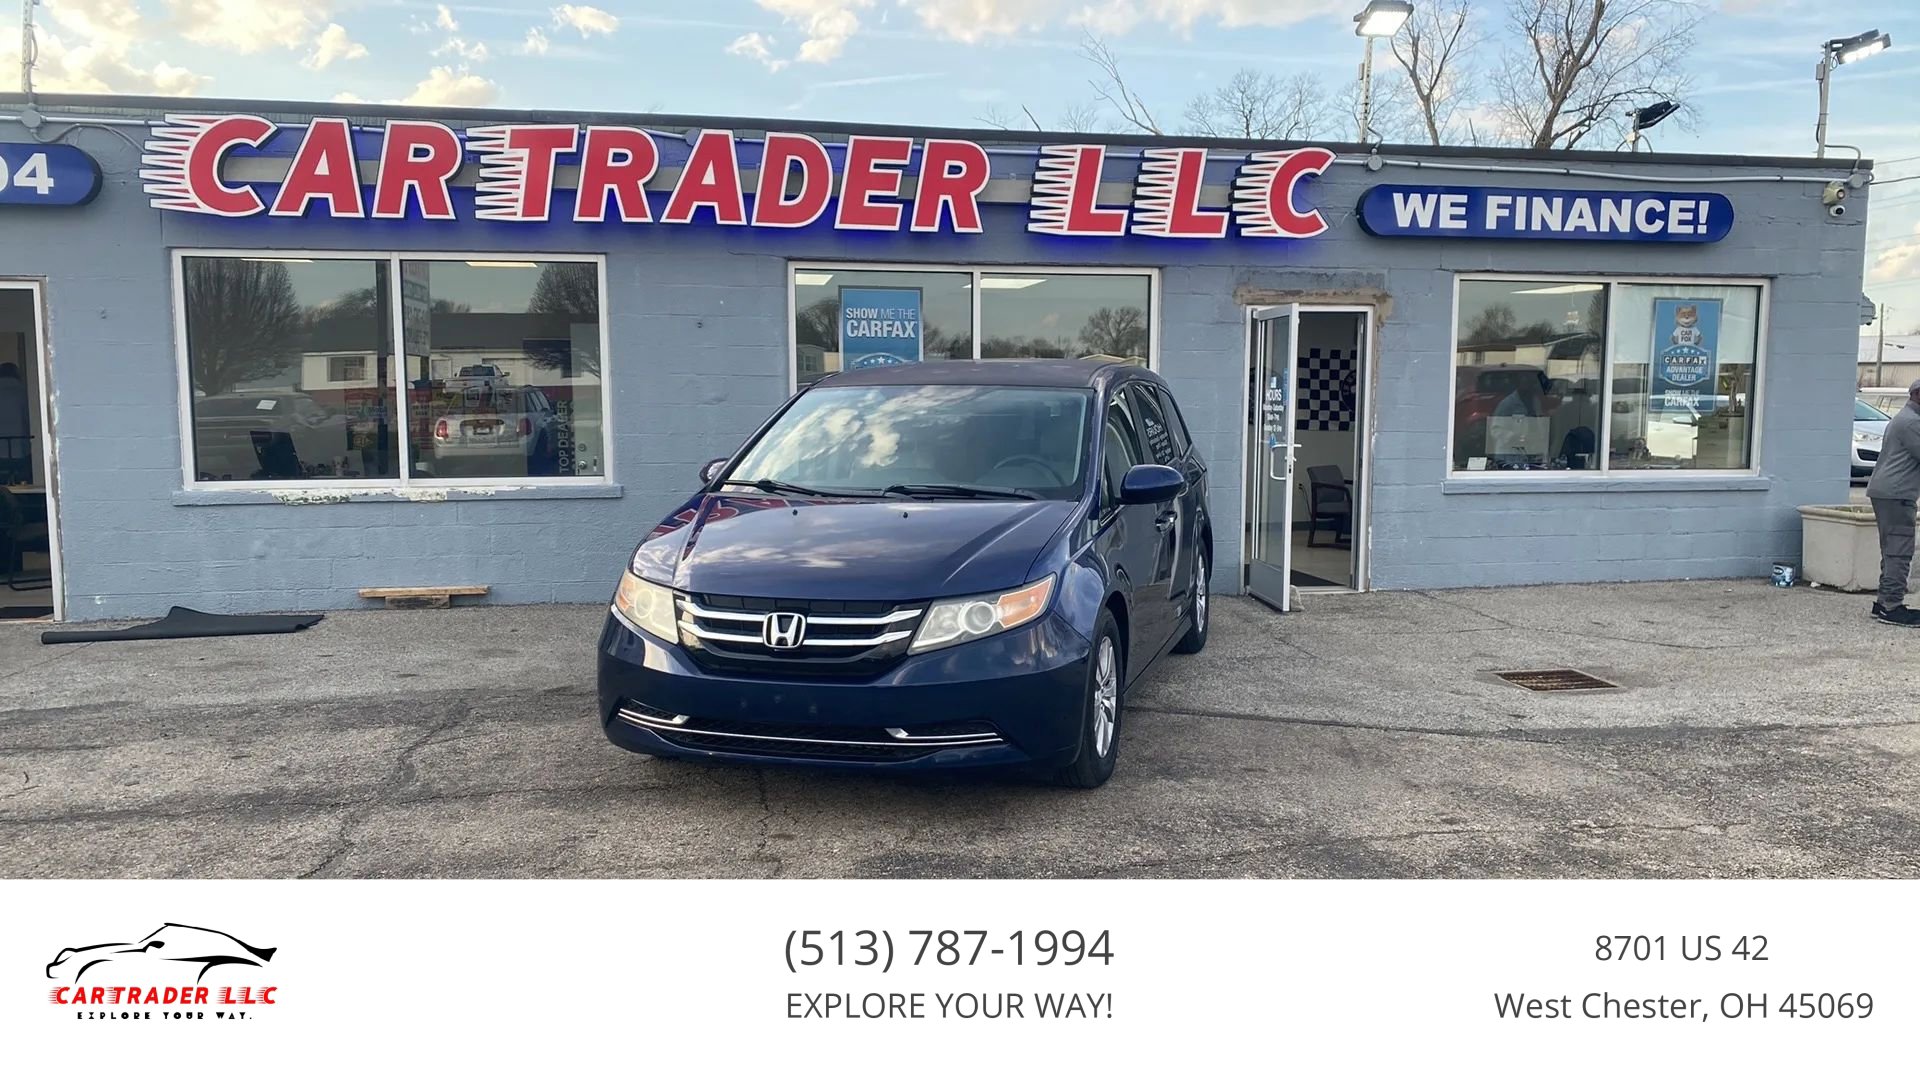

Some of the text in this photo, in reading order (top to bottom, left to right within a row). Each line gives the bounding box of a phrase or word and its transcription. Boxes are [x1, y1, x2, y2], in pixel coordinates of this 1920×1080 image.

[1026, 144, 1338, 239] LLC
[1392, 192, 1710, 235] WE FINANCE!
[846, 307, 917, 320] SHOW ME THE
[846, 319, 916, 338] CARFAX
[1664, 356, 1707, 365] CARFAX
[1666, 366, 1703, 374] ADVANTAGE
[1265, 388, 1282, 401] HOURS
[559, 450, 569, 473] TOP
